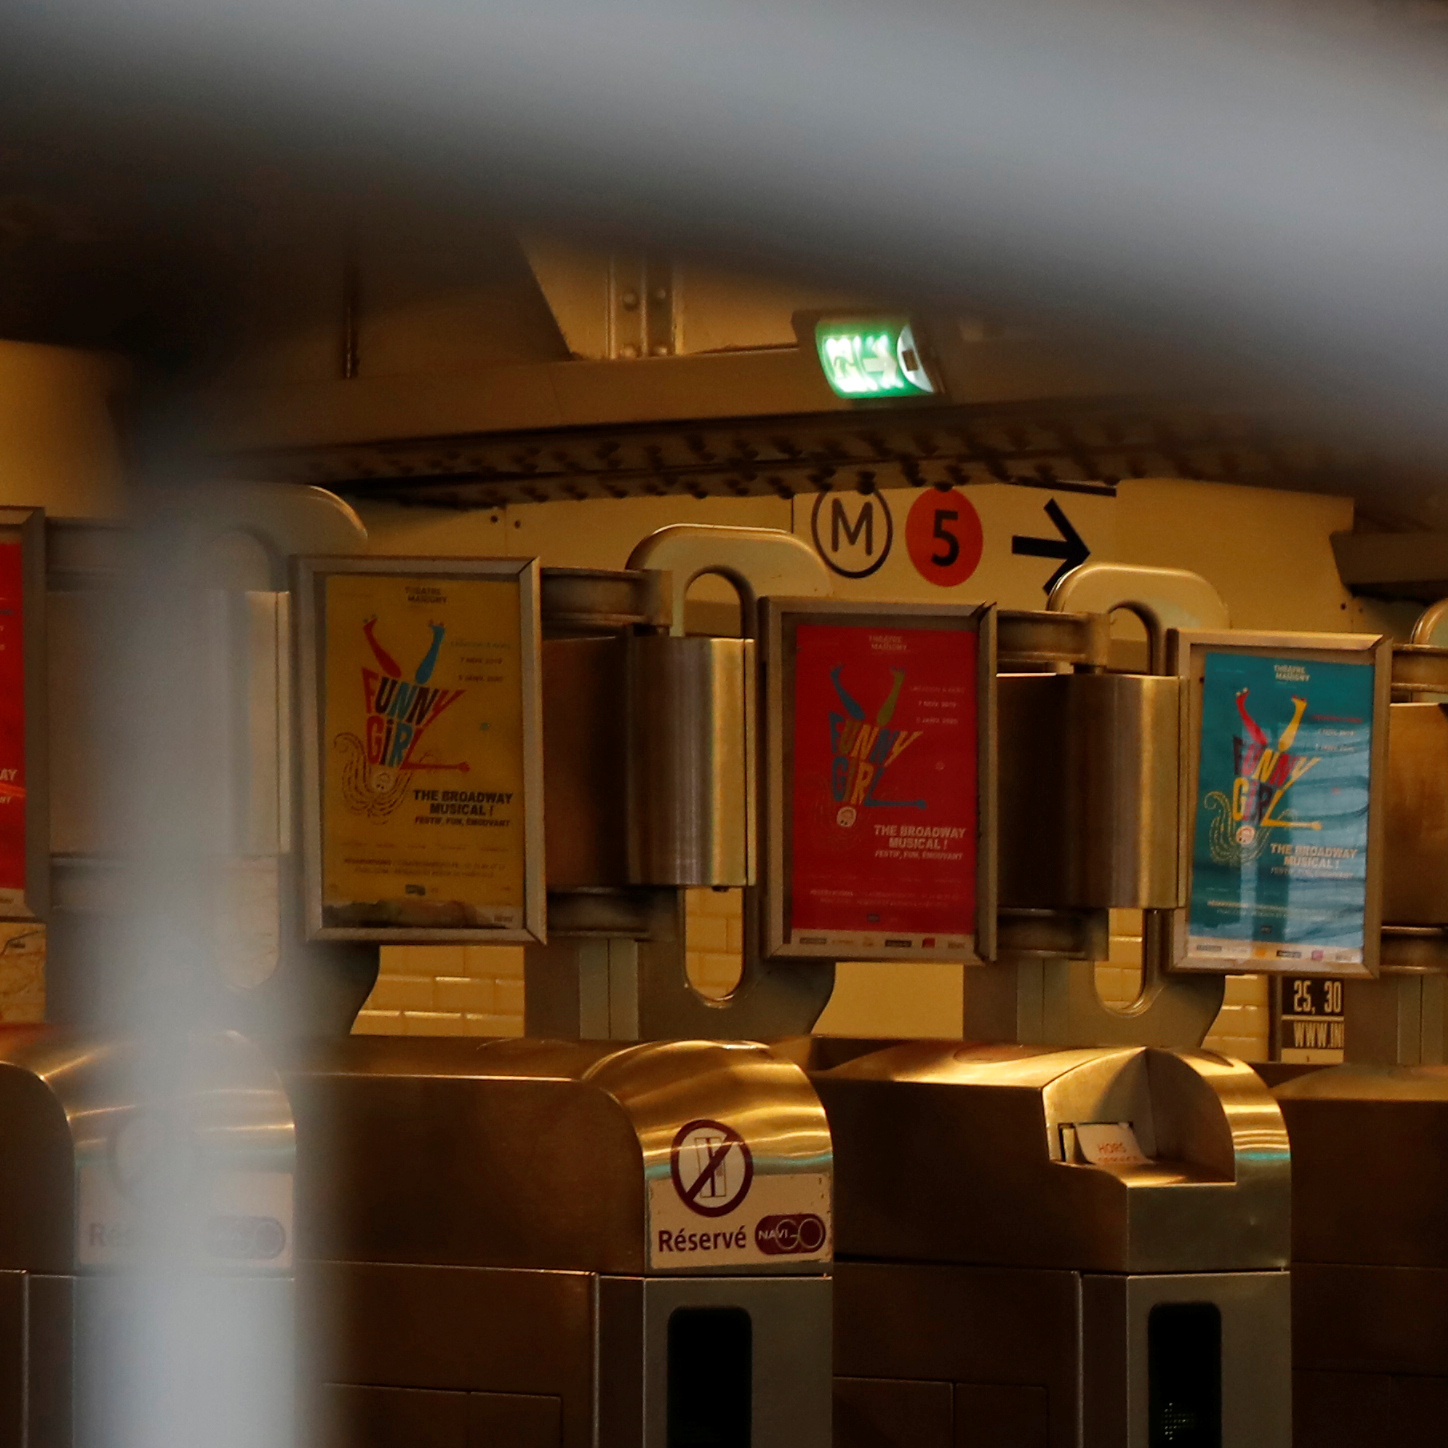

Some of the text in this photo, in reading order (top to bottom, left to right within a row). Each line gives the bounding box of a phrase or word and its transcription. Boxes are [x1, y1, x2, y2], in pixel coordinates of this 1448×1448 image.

[931, 509, 960, 567] 5
[361, 666, 467, 727] FUNNY
[828, 711, 924, 768] FUNNY
[1233, 733, 1322, 790] FUNNY
[414, 789, 513, 804] THE BROADWAY
[430, 803, 486, 816] MUSICAL
[874, 824, 967, 839] THE BROADWAY
[889, 837, 941, 850] MUSICAL
[1271, 843, 1358, 859] THE BROADWAY
[1324, 980, 1342, 1014] 30
[657, 1225, 747, 1252] Réservé
